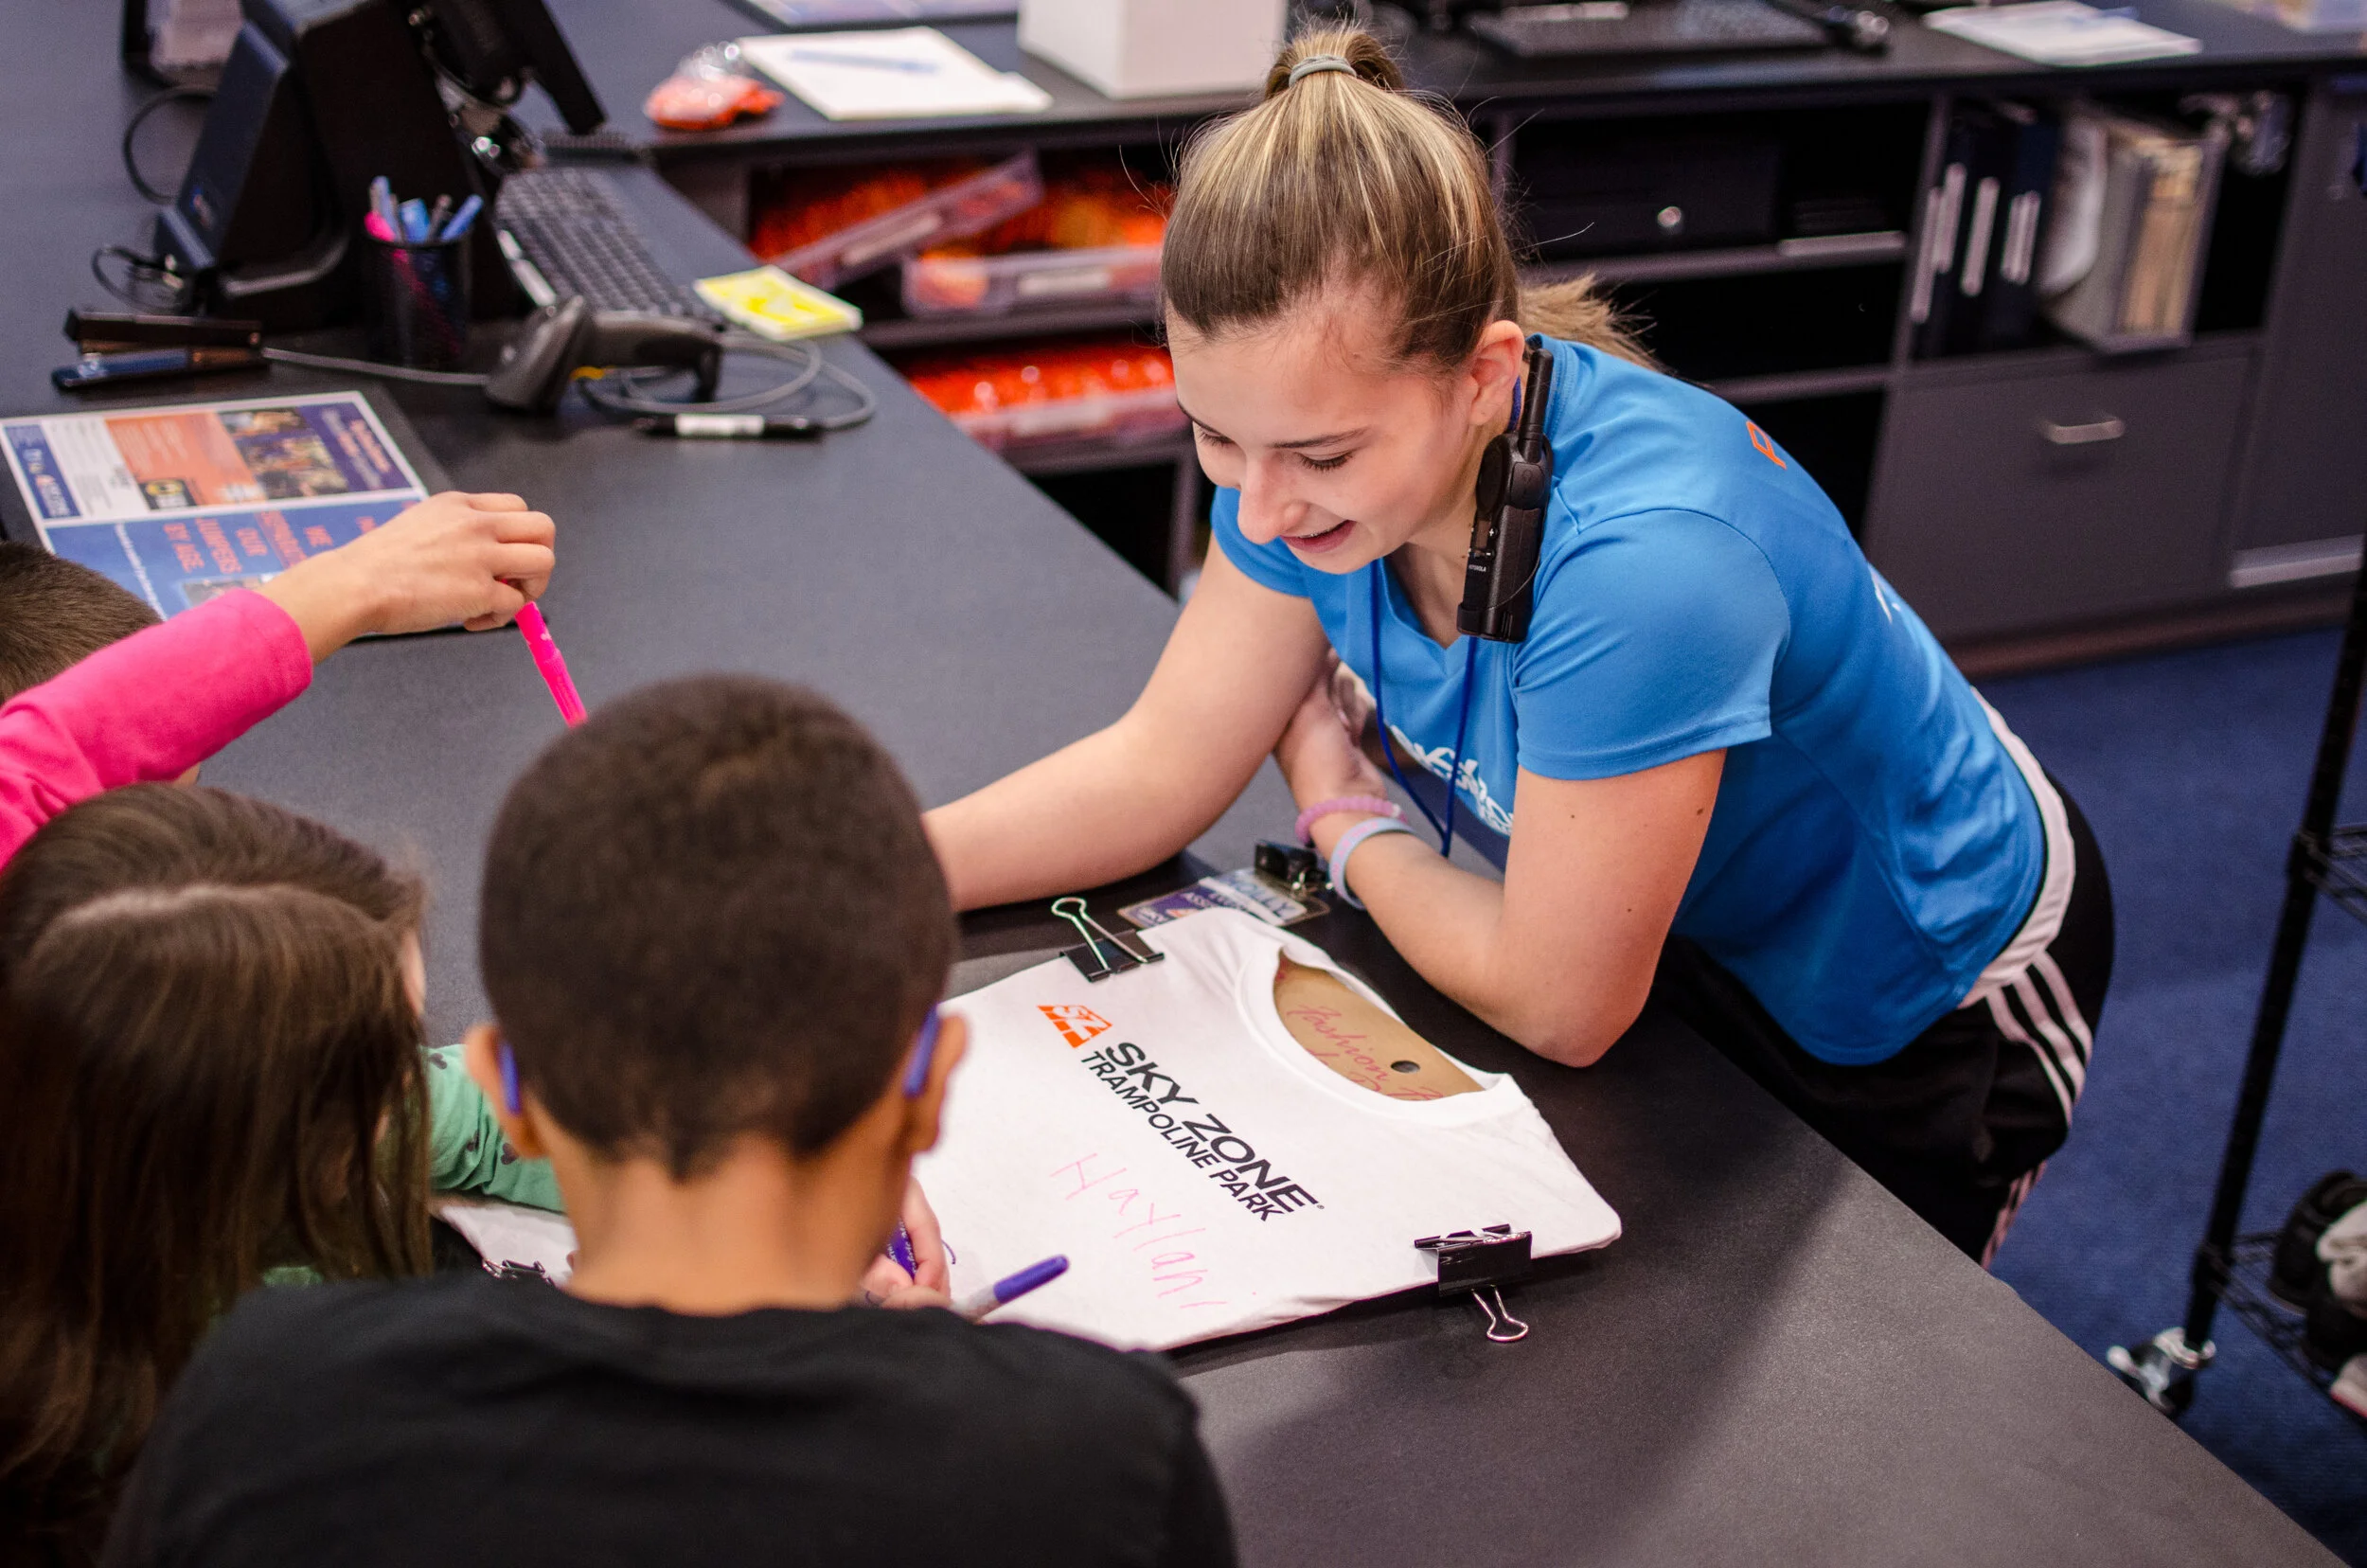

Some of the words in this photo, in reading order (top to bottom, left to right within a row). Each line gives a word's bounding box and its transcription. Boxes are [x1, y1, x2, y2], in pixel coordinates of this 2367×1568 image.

[195, 517, 242, 574] JUMPERS
[1080, 1050, 1221, 1169] TRAMPOLINE
[1208, 1169, 1285, 1222] PARK
[1105, 1042, 1200, 1105] SKY
[1182, 1114, 1319, 1213] ZONE
